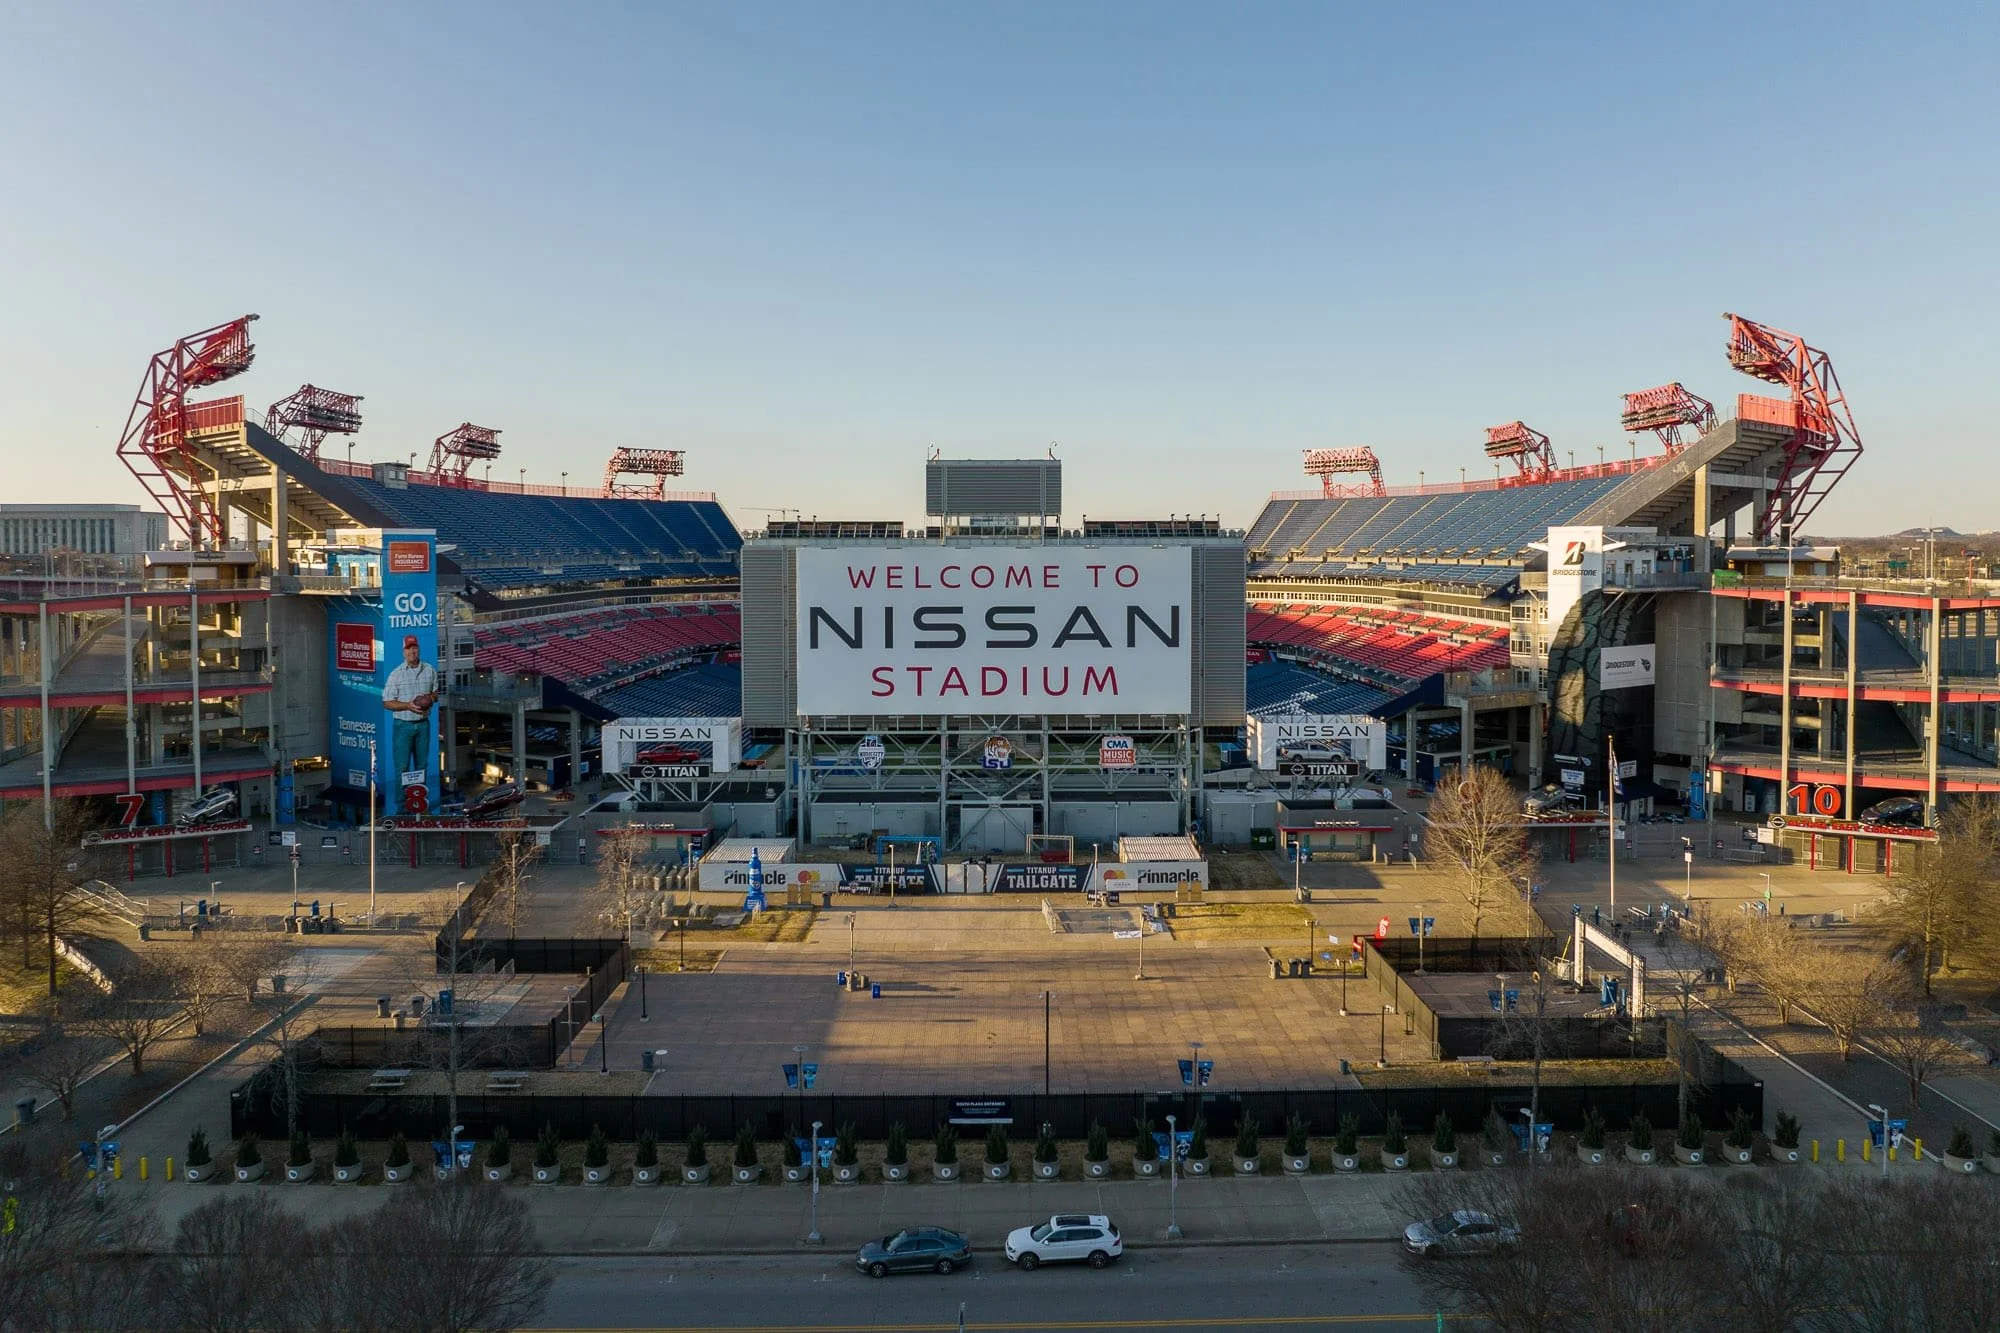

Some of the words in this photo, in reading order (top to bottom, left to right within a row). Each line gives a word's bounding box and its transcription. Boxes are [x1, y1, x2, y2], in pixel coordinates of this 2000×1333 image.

[847, 565, 1060, 589] WELCOME
[1086, 564, 1139, 588] TO
[1552, 569, 1598, 577] BRIDGESTONE
[394, 592, 427, 613] GO
[388, 613, 433, 628] TITANS!
[809, 605, 1180, 649] NISSAN
[341, 641, 353, 650] Farm
[341, 650, 370, 660] INSURANCE
[871, 666, 1119, 697] STADIUM
[338, 716, 376, 734] Tennessee
[1279, 726, 1369, 737] NISSAN
[620, 728, 711, 739] NISSAN
[357, 735, 367, 749] To
[1106, 740, 1129, 749] CMA
[1103, 750, 1133, 759] MUSIC
[659, 766, 700, 777] TITAN
[1308, 764, 1348, 775] TITAN
[405, 783, 429, 814] 8
[1787, 784, 1842, 816] 10
[116, 794, 145, 826] 7
[103, 831, 144, 841] ROGUE
[147, 827, 176, 837] WEST
[724, 869, 786, 885] Pincle
[1006, 874, 1077, 889] TAILGATE
[1137, 868, 1200, 884] Pinnacle
